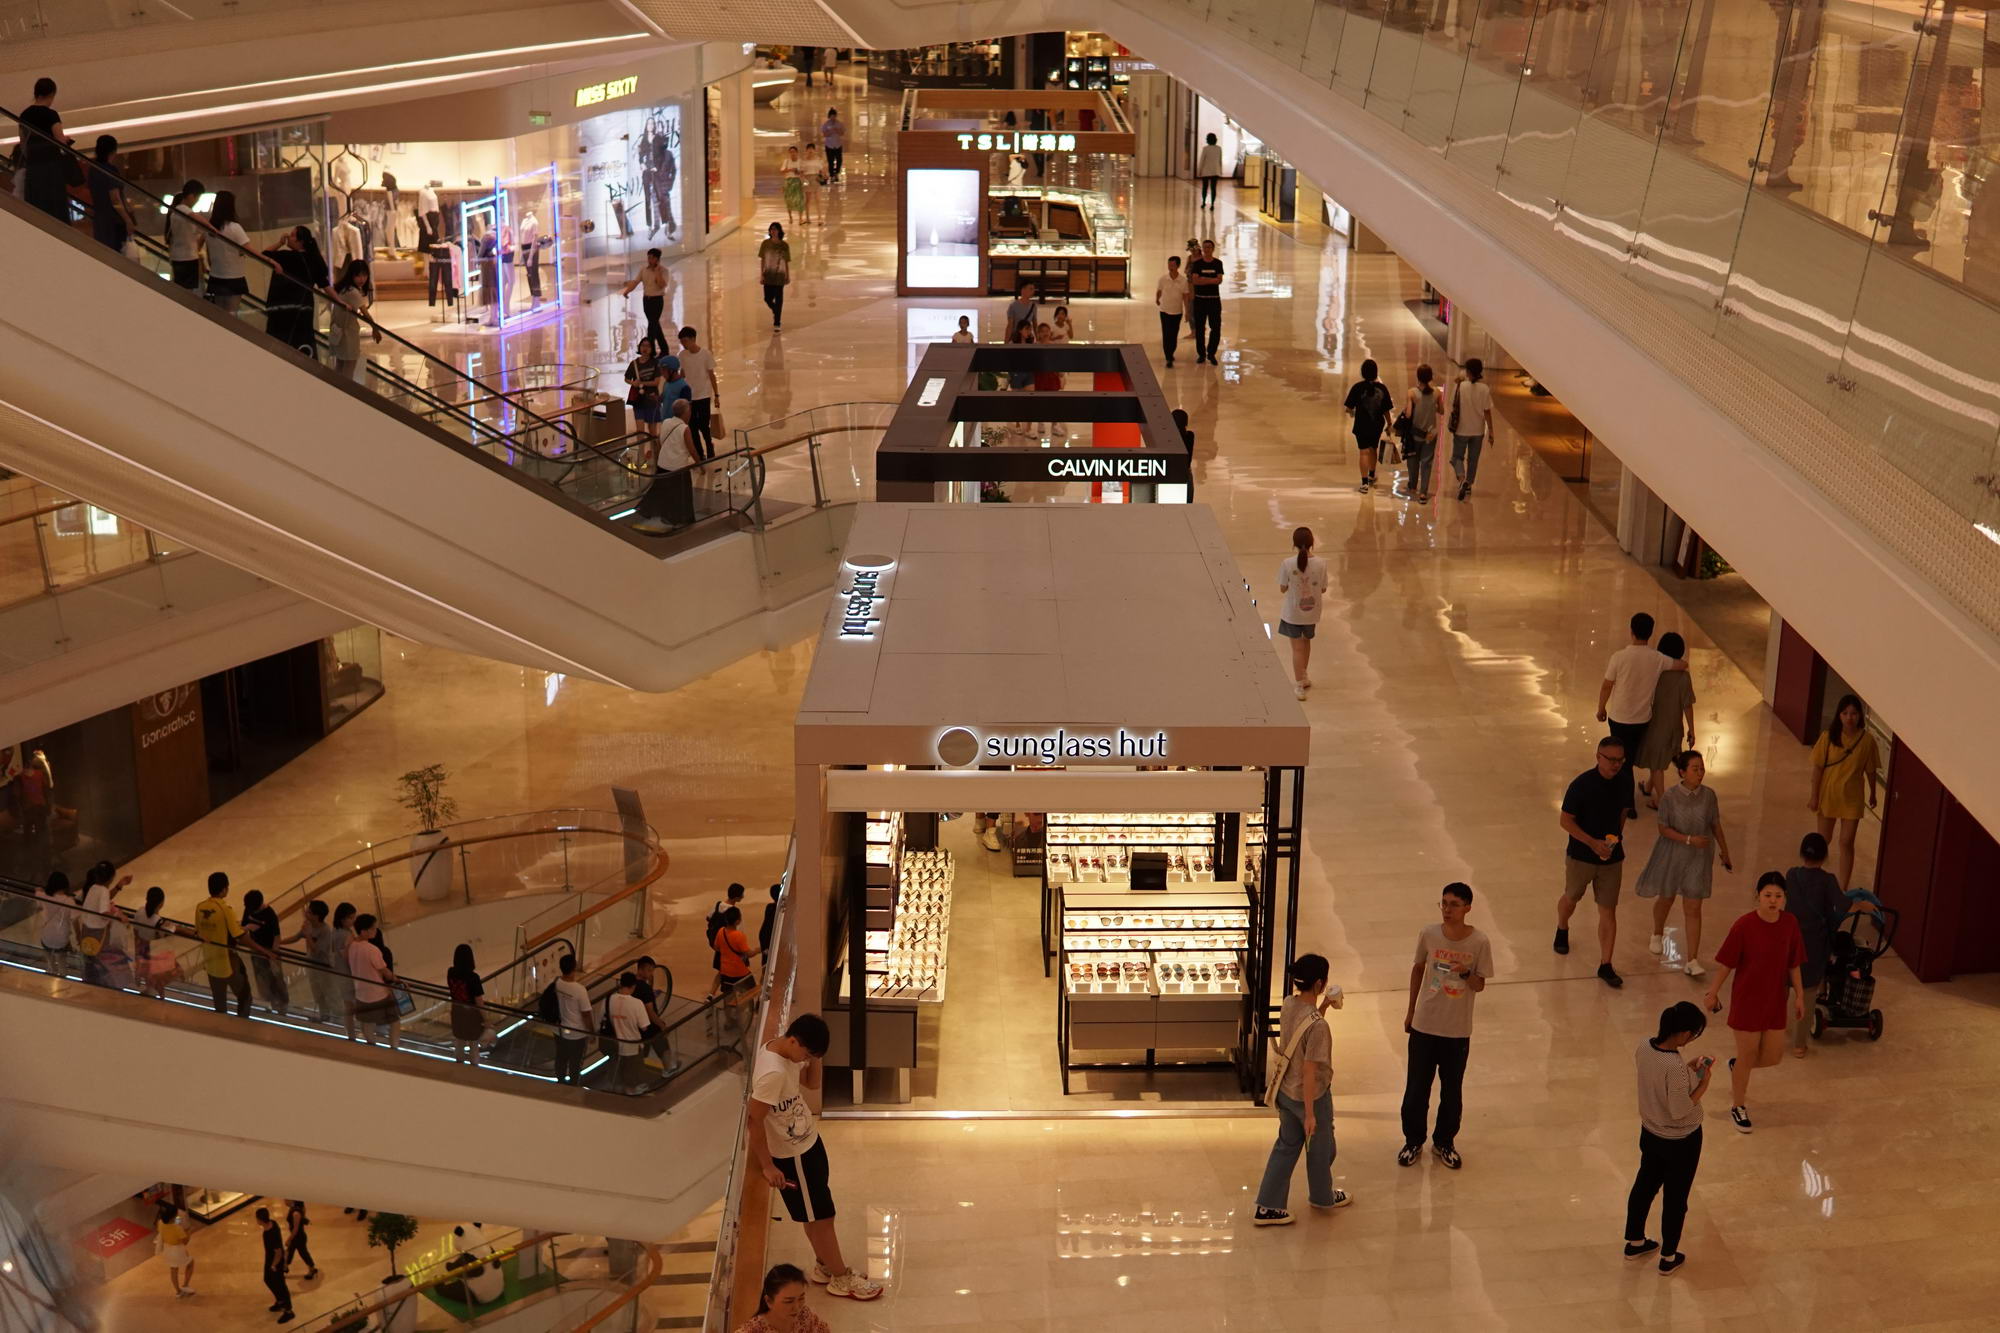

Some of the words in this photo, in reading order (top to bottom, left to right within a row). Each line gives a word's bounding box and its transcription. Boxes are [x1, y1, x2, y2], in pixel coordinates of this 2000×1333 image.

[576, 84, 606, 107] MISS
[606, 76, 638, 100] SIXTY
[957, 134, 1011, 151] TSL
[1047, 459, 1114, 477] CALVIN
[1117, 459, 1167, 477] KLEIN
[841, 571, 885, 616] sunglass
[840, 617, 880, 637] hut
[987, 729, 1111, 765] sunglass
[1120, 730, 1167, 758] hut
